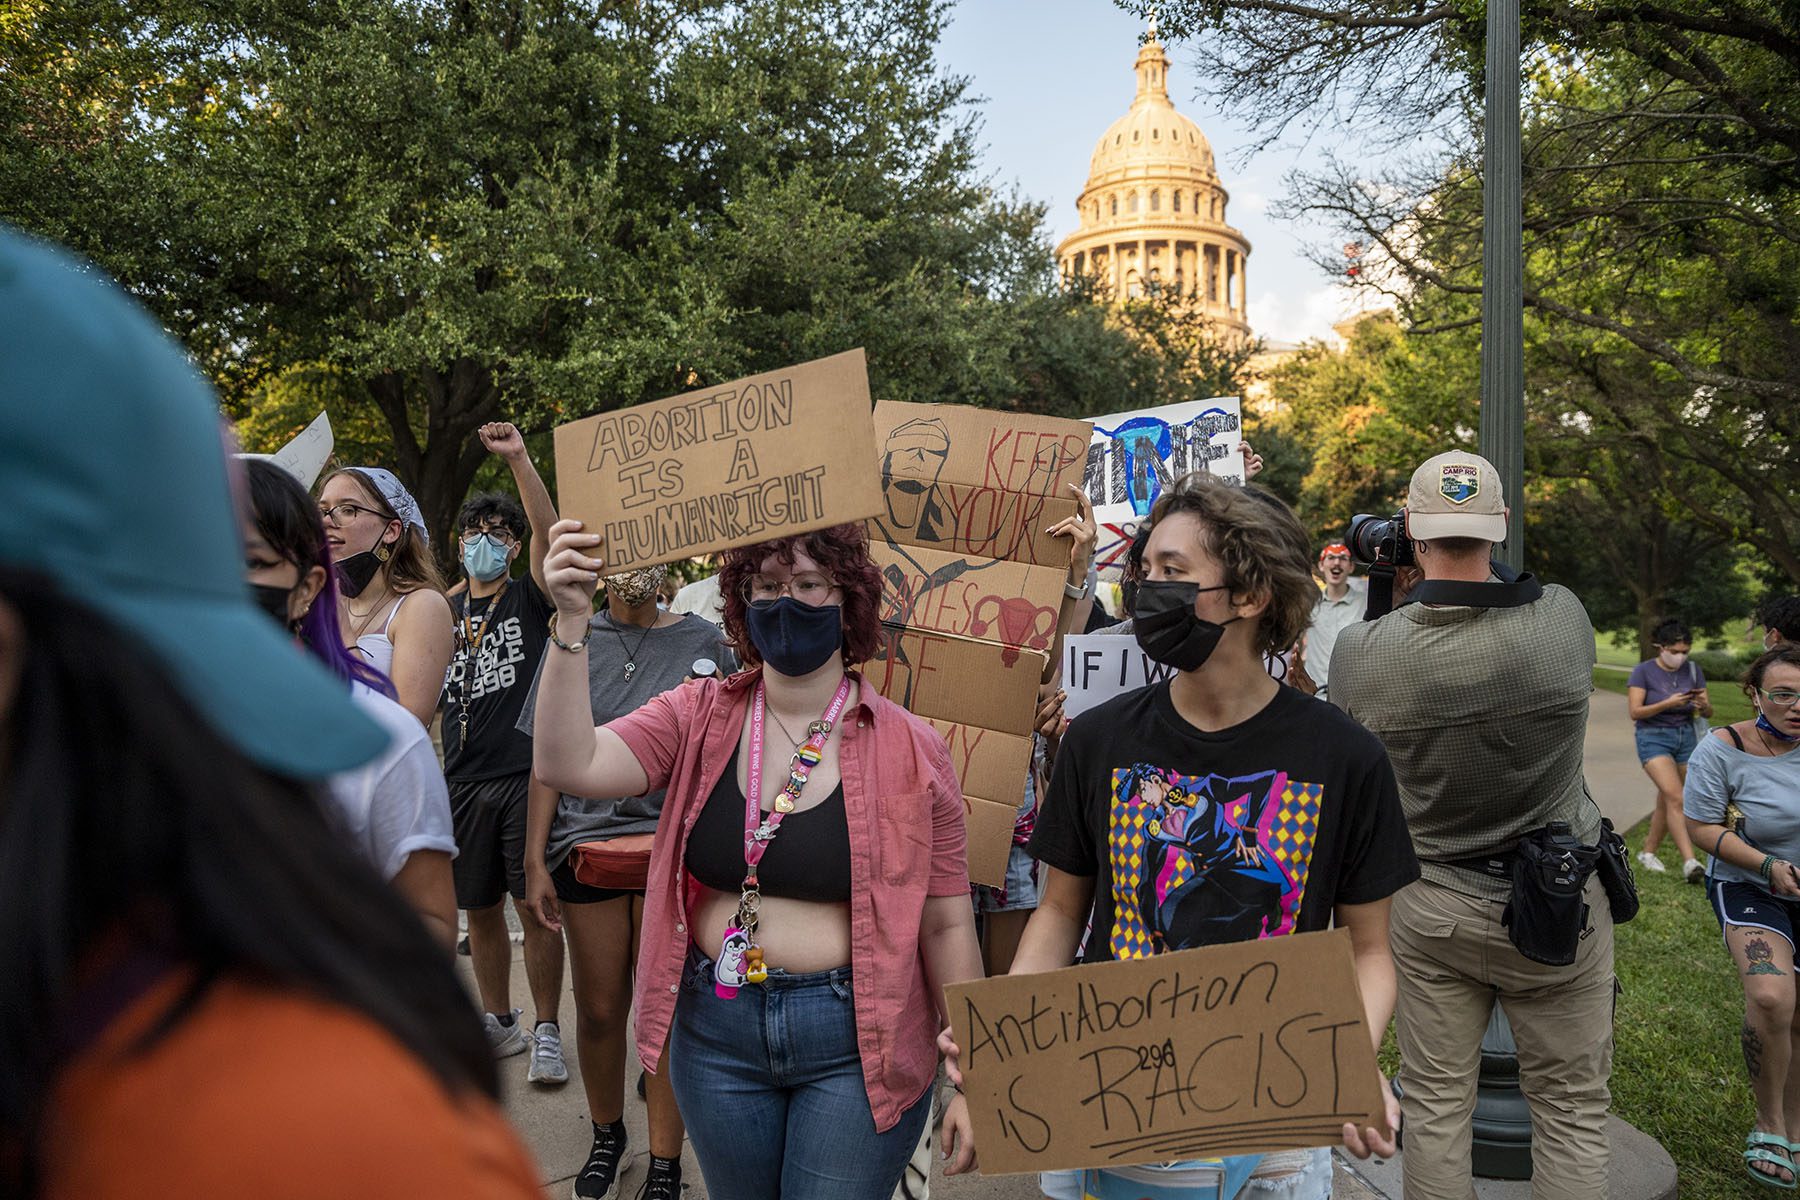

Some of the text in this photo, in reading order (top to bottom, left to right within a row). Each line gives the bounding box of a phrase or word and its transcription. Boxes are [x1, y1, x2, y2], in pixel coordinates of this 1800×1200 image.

[587, 379, 792, 472] ABORTION
[618, 438, 759, 509] IS A
[983, 427, 1085, 498] KEEP
[949, 484, 1038, 565] YOUR
[1070, 646, 1102, 690] IF
[1119, 648, 1129, 687] I
[754, 690, 762, 721] MARRIED
[824, 696, 843, 723] MARRIE
[753, 722, 761, 742] ONCE
[751, 753, 760, 769] WINS
[752, 743, 760, 752] HE
[750, 778, 758, 798] GOLD
[749, 799, 757, 823] MEDAL
[1137, 1044, 1175, 1070] 296
[993, 1012, 1361, 1153] is RACIST
